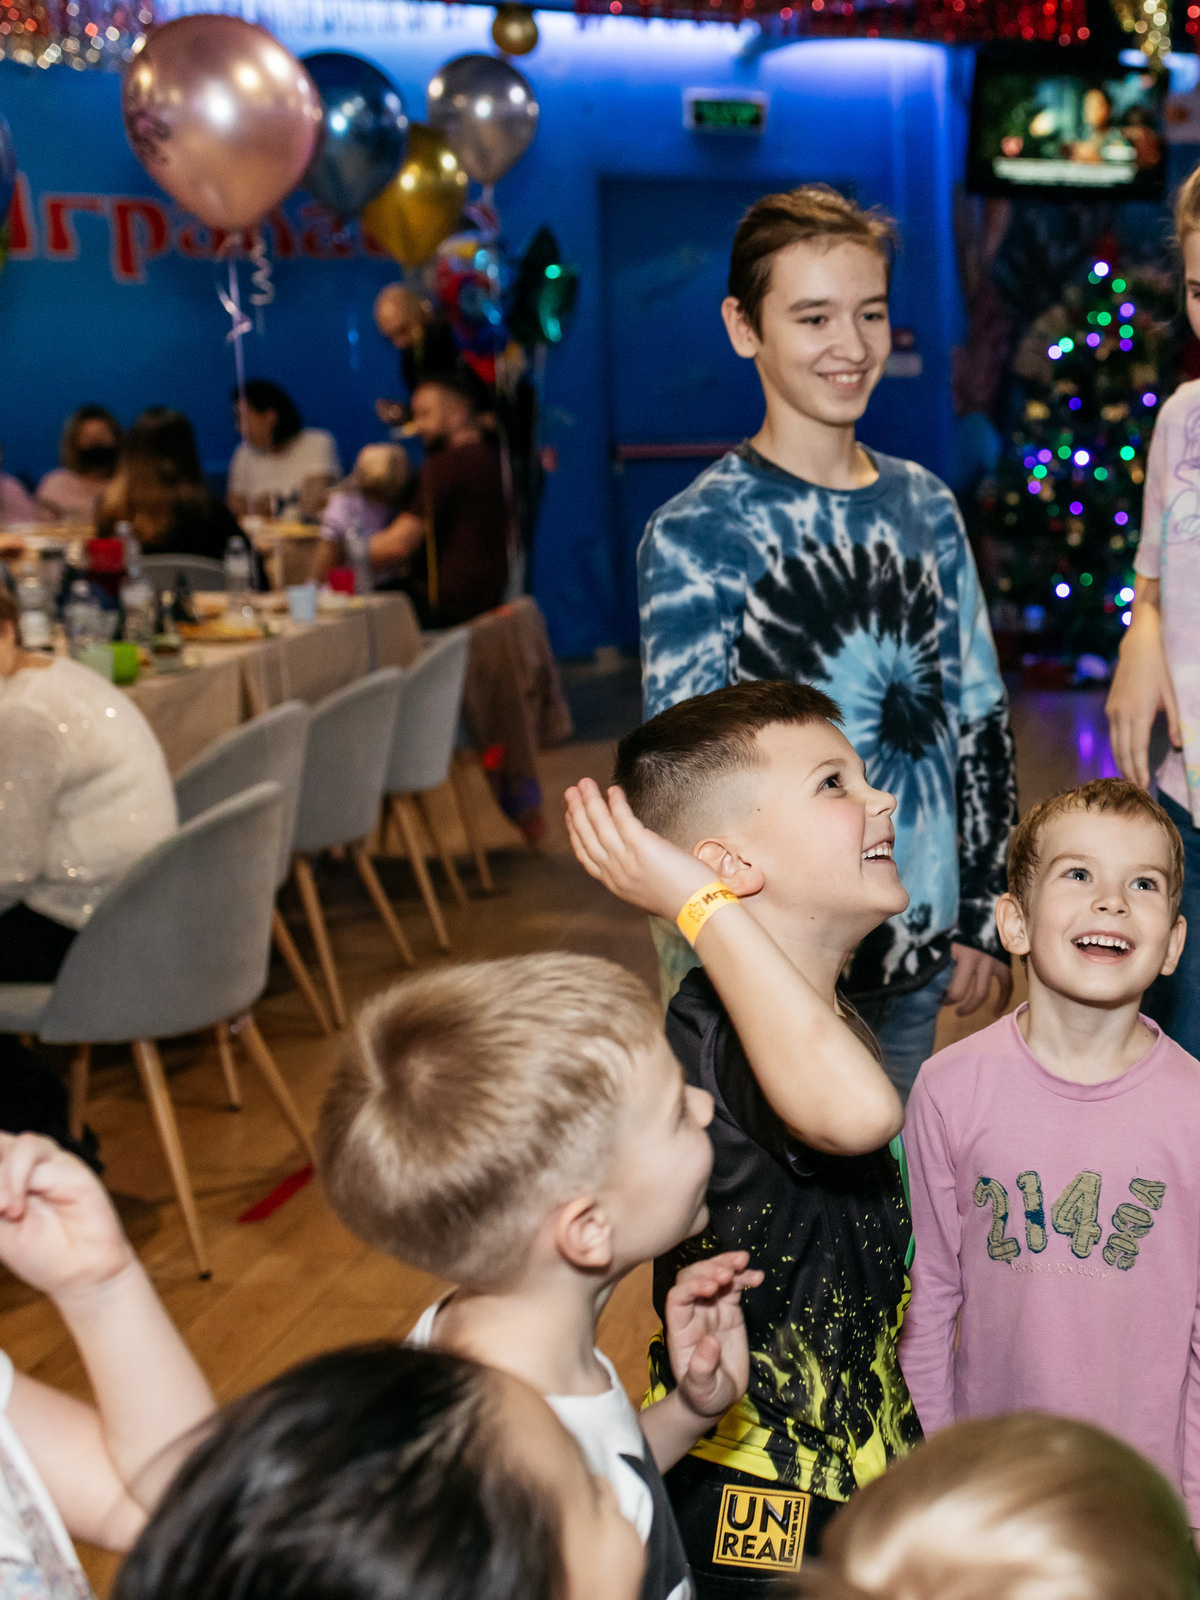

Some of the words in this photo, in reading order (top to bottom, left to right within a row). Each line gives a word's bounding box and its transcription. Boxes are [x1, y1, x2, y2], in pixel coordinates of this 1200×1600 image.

[972, 1169, 1103, 1262] 214
[727, 1494, 792, 1536] UN
[721, 1532, 792, 1562] REAL
